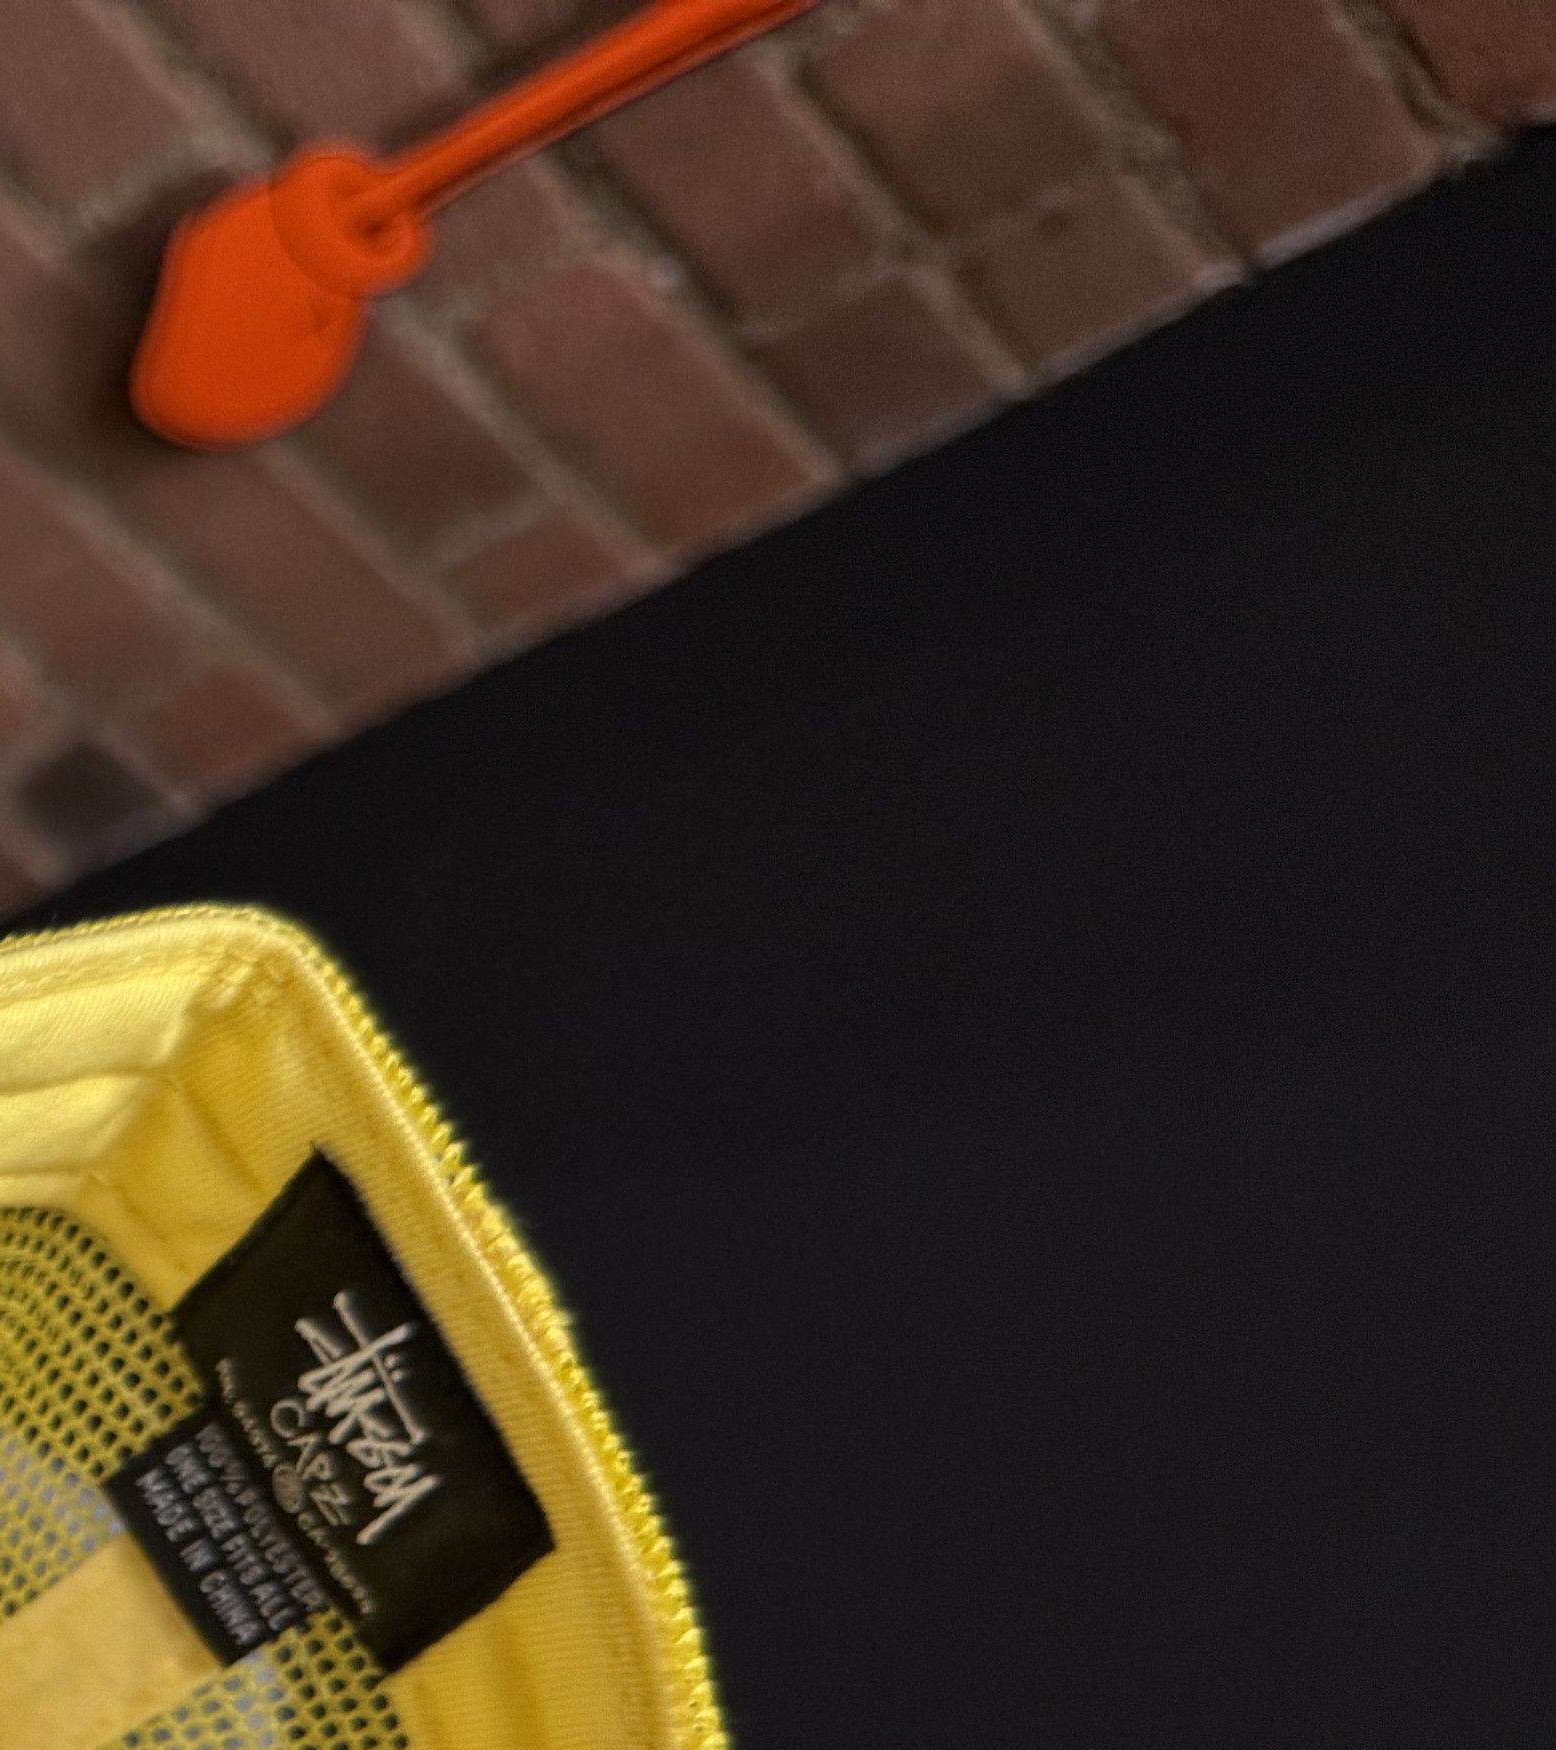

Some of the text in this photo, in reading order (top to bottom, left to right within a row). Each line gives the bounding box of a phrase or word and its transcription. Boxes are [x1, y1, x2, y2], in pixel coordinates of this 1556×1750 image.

[139, 1470, 258, 1641] MADE IN CHINA
[194, 1490, 234, 1537] SIZE
[223, 1536, 263, 1584] FITS
[253, 1585, 288, 1629] ALL
